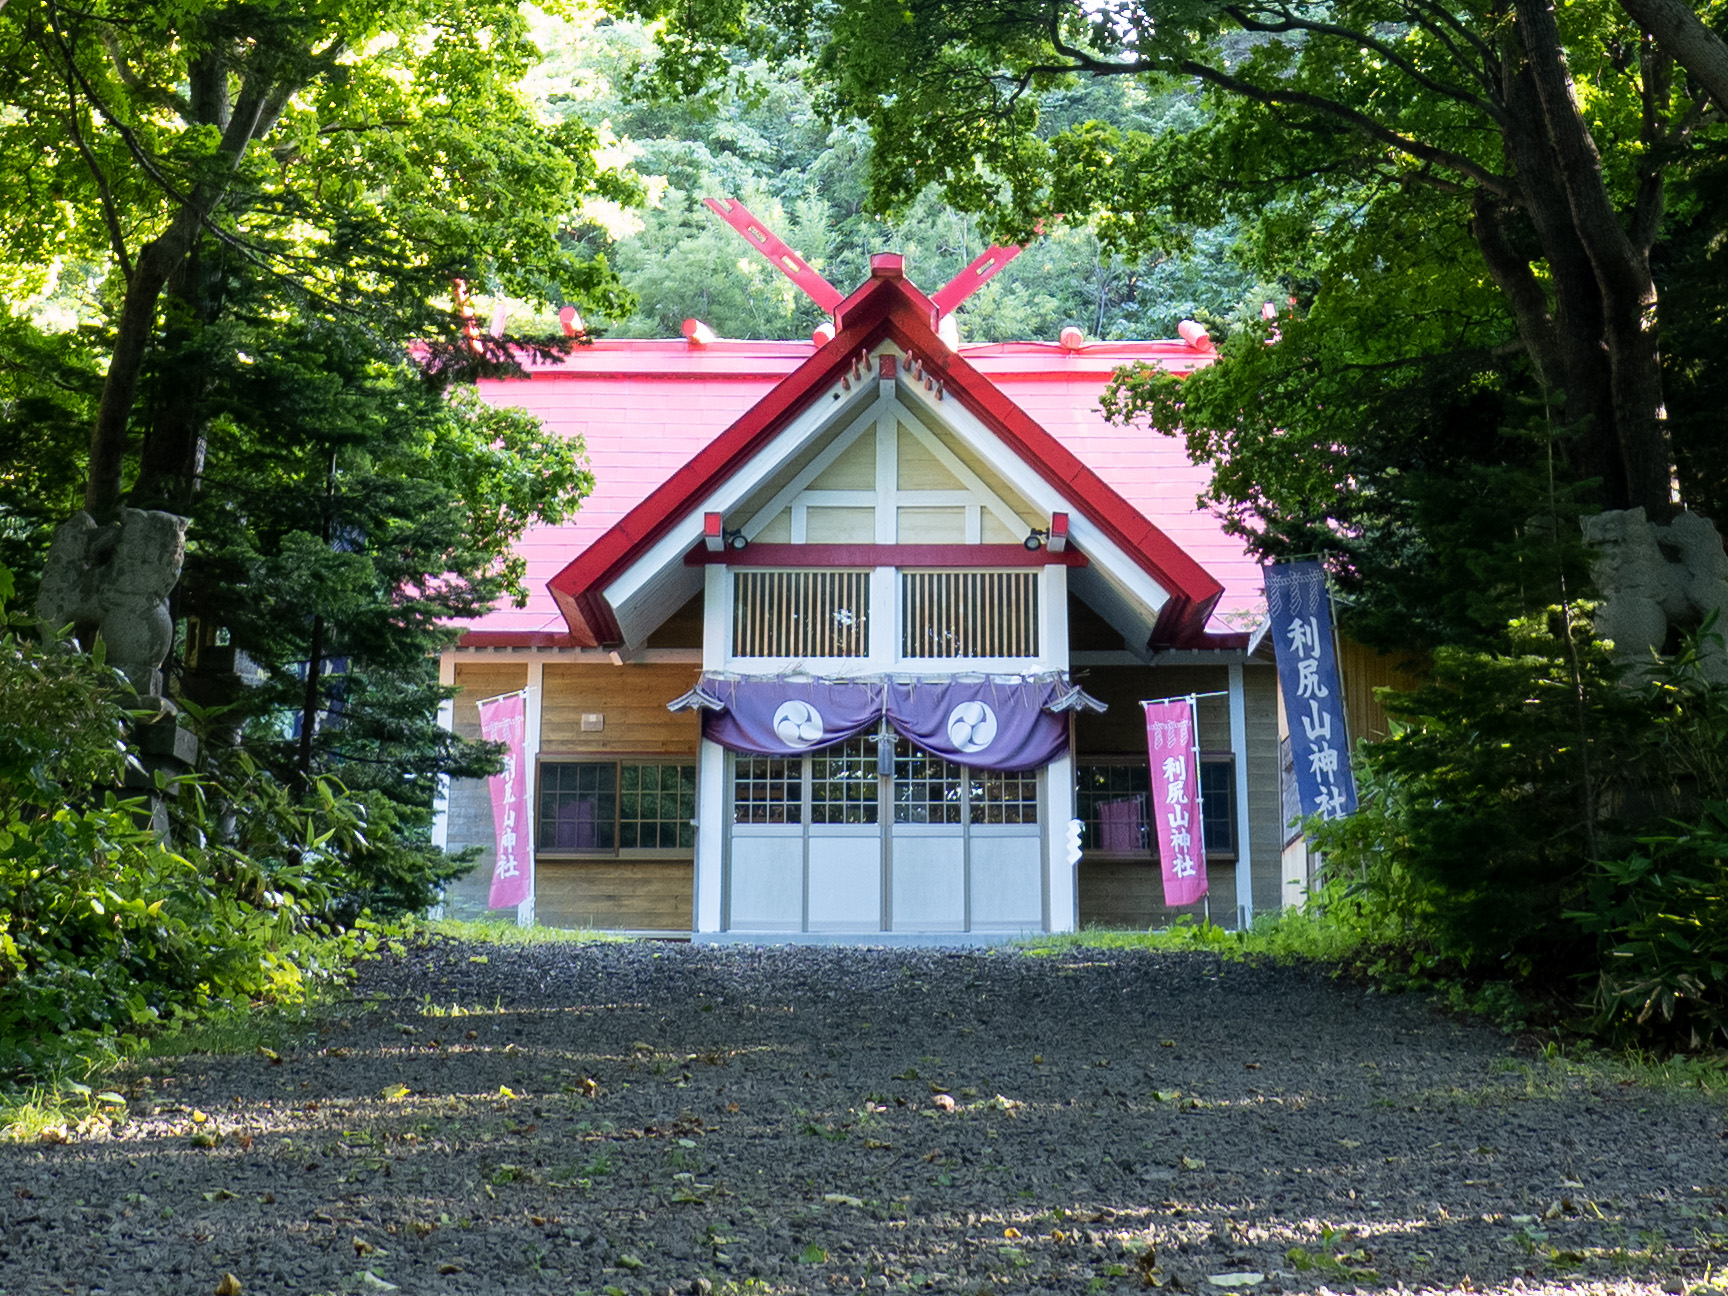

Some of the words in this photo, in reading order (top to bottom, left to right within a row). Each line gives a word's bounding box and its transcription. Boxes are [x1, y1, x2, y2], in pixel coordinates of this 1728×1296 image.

[1285, 615, 1346, 821] 利尻山神社
[1161, 754, 1197, 879] 利尻山神社
